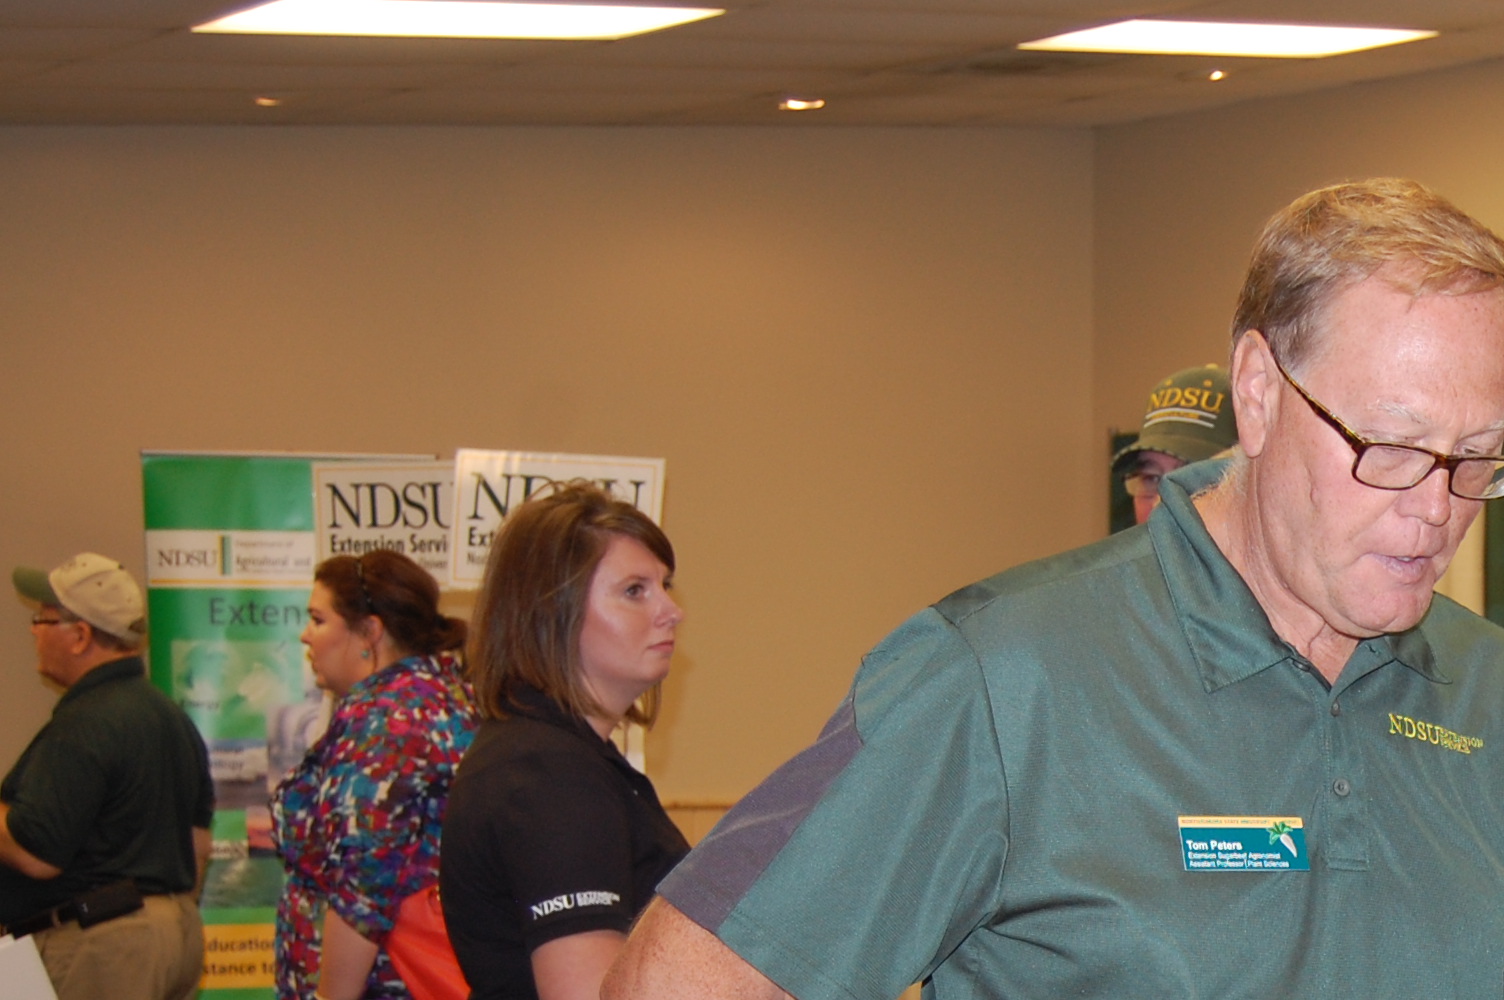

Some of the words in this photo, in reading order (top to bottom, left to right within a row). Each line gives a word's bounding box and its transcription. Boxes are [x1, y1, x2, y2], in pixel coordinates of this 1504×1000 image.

[1147, 386, 1225, 414] NDSU
[330, 534, 405, 553] Extension
[157, 549, 218, 567] NDSU
[209, 598, 309, 626] Exten
[1388, 712, 1441, 745] NDSU
[1186, 839, 1208, 851] Tom
[1210, 840, 1243, 851] Peters
[531, 893, 575, 920] NDSU
